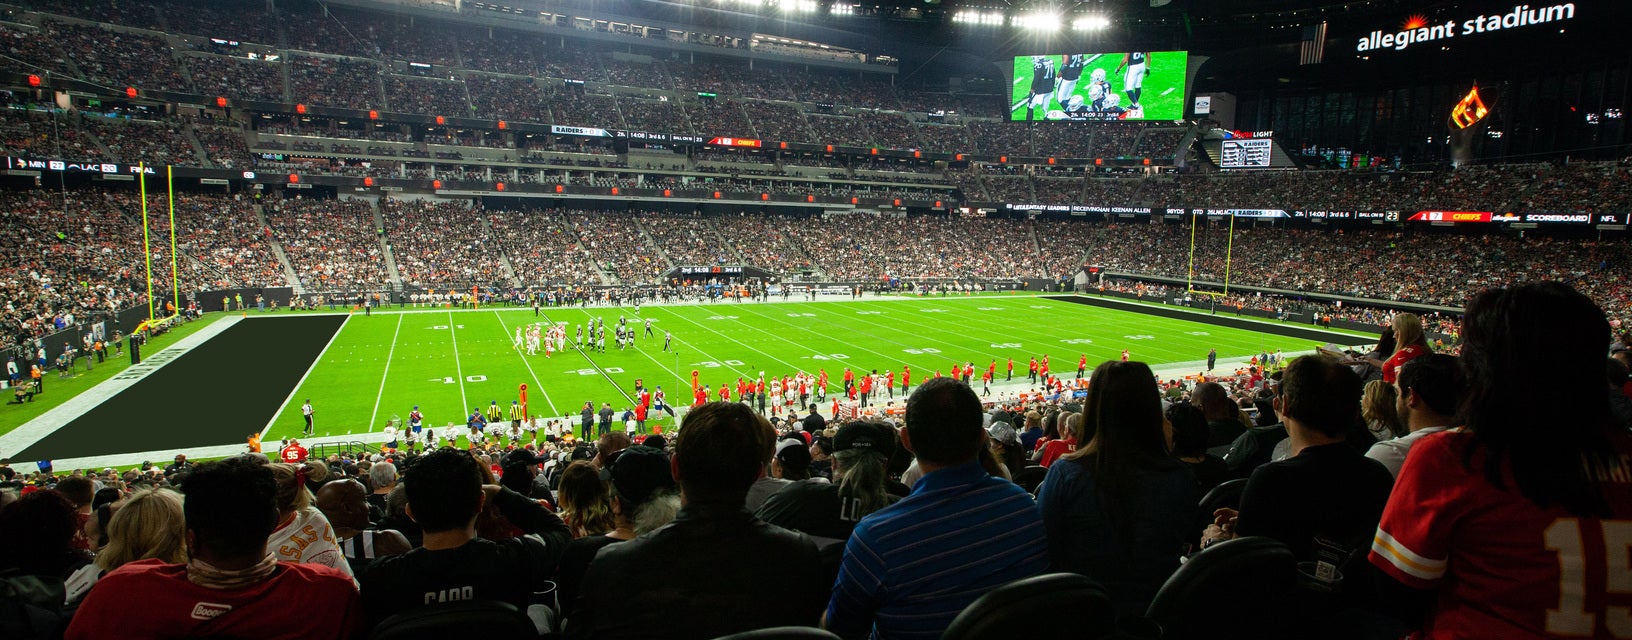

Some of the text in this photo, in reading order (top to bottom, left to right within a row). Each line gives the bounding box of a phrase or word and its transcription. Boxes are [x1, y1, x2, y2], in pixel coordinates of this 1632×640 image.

[1356, 2, 1575, 51] allegiant stadium
[28, 160, 46, 168] MIN
[1387, 212, 1398, 220] 23
[576, 367, 625, 376] 20
[443, 375, 488, 384] 10
[286, 450, 298, 460] 95
[279, 525, 318, 562] SAS
